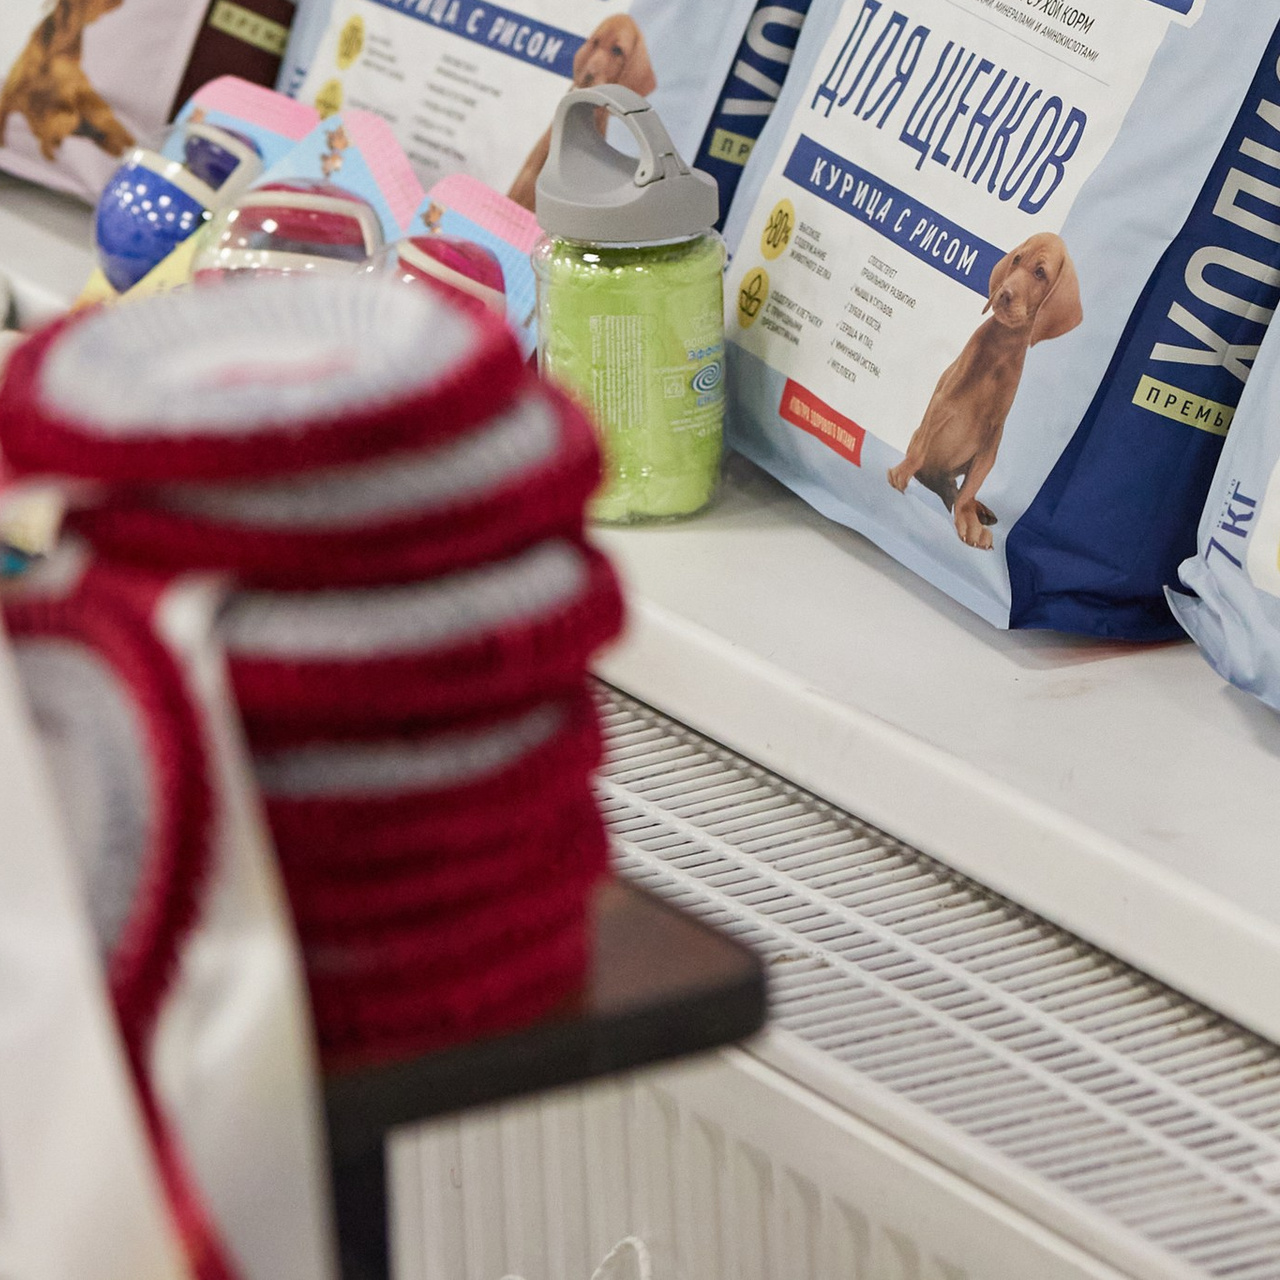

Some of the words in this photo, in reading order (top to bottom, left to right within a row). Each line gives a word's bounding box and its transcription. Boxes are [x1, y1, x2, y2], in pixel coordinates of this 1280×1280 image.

[465, 11, 482, 34] С
[488, 17, 565, 66] РИСОМ
[994, 0, 1035, 29] МИНЕРАЛАМИ
[1033, 21, 1041, 32] И
[1040, 26, 1100, 63] АМИНОКИСЛОТАМИ
[1061, 5, 1096, 35] КОРМ
[898, 40, 1089, 216] ЩЕНКОВ
[809, 156, 895, 224] КУРИЦА
[895, 208, 911, 232] С
[909, 218, 980, 277] РИСОМ
[1205, 536, 1243, 570] 7
